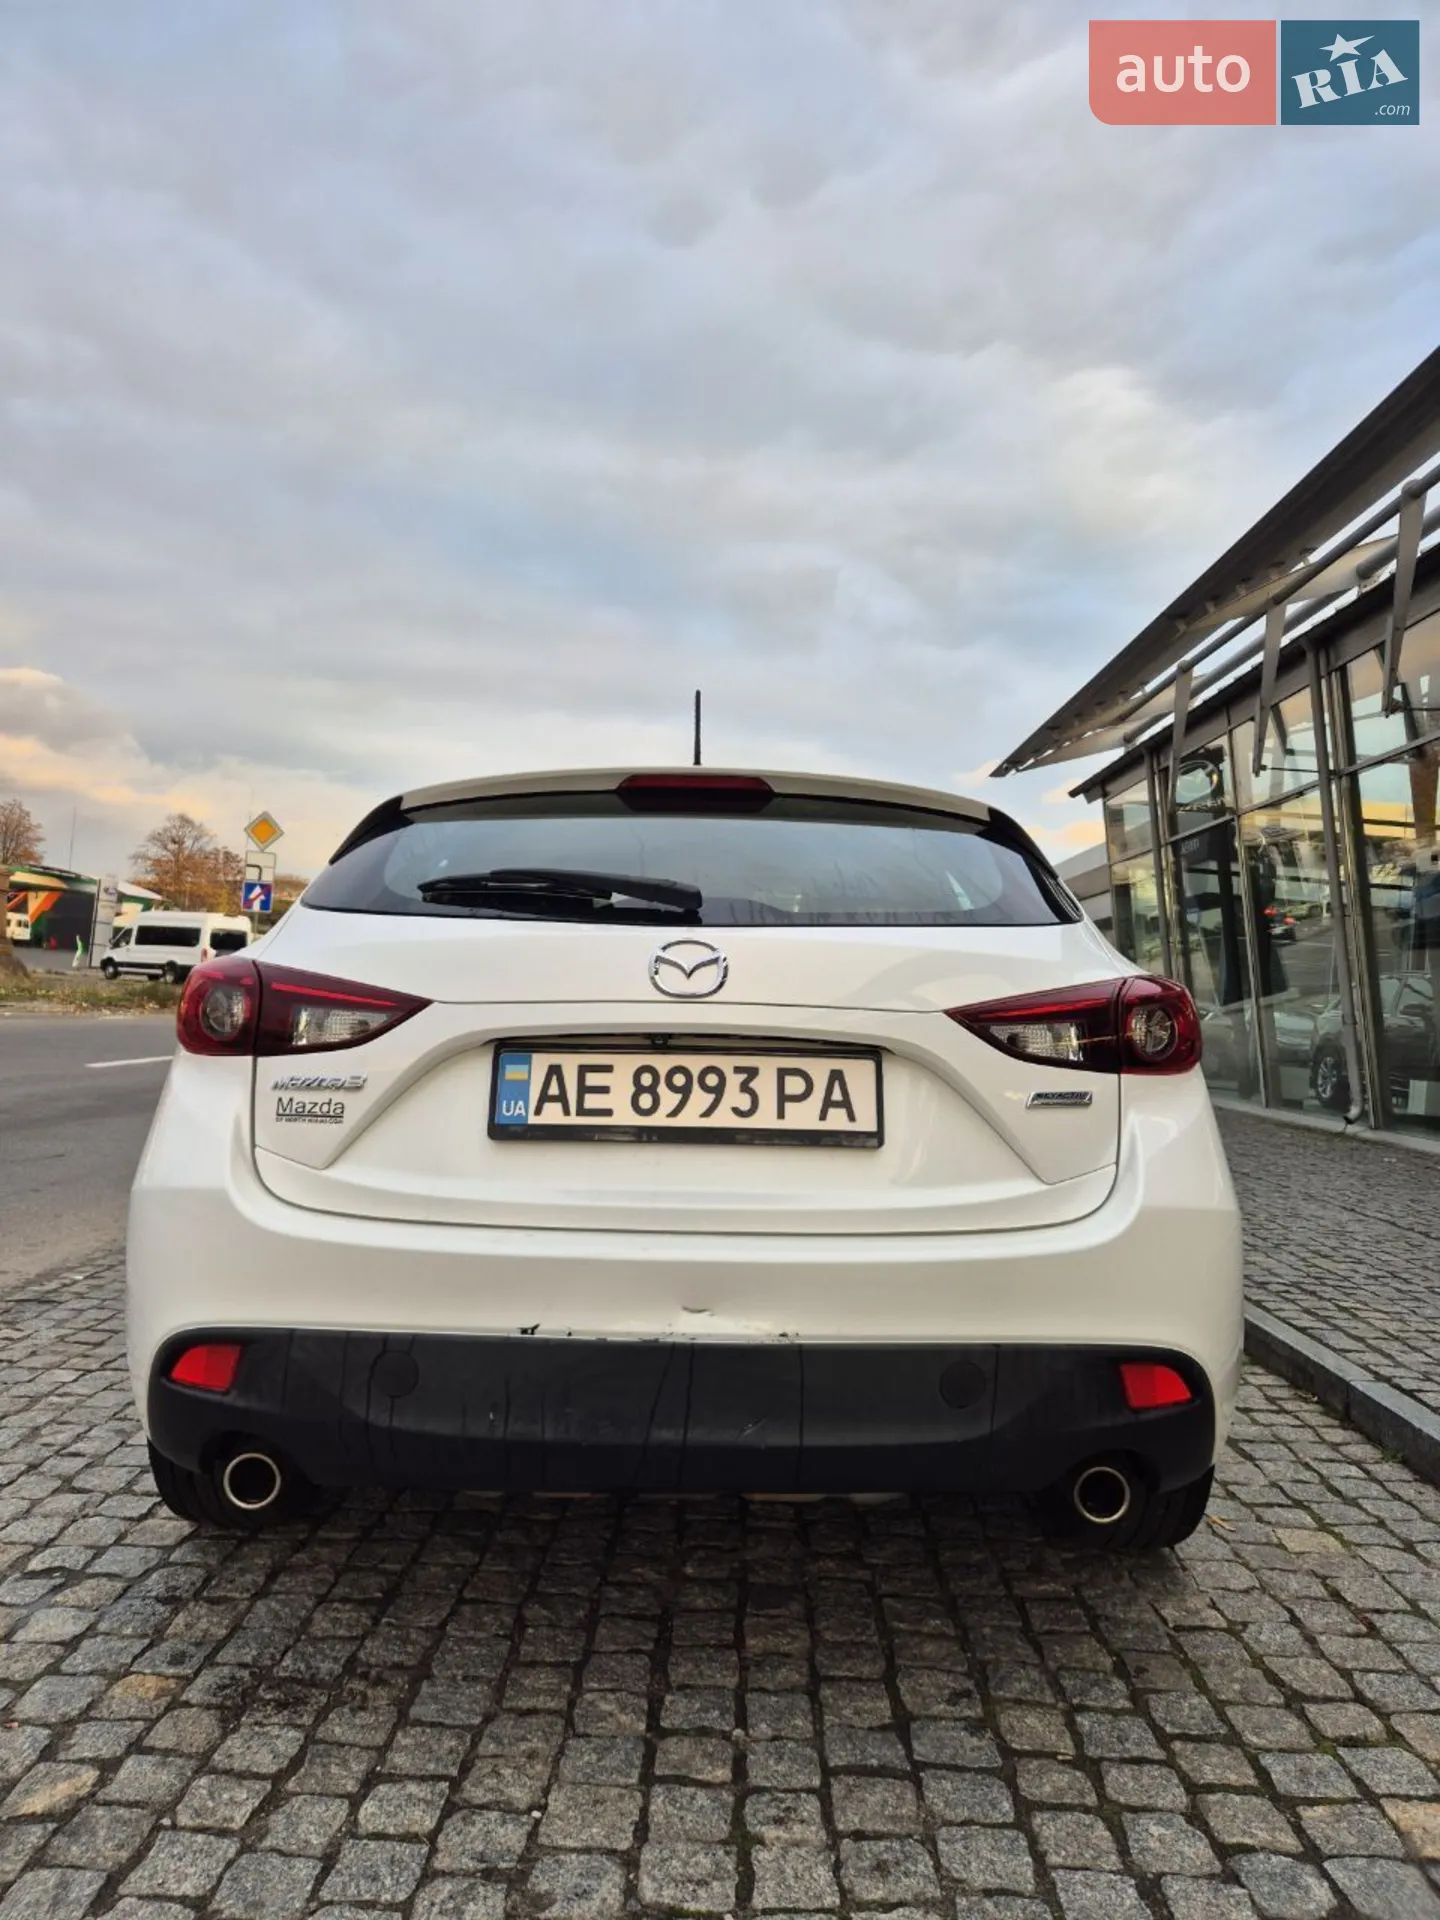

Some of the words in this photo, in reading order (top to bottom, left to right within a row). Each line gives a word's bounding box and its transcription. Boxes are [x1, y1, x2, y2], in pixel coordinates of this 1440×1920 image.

[533, 1064, 614, 1118] AE
[630, 1065, 760, 1119] 8993
[776, 1067, 857, 1123] PA
[276, 1097, 345, 1115] Mazda
[502, 1101, 526, 1117] UA
